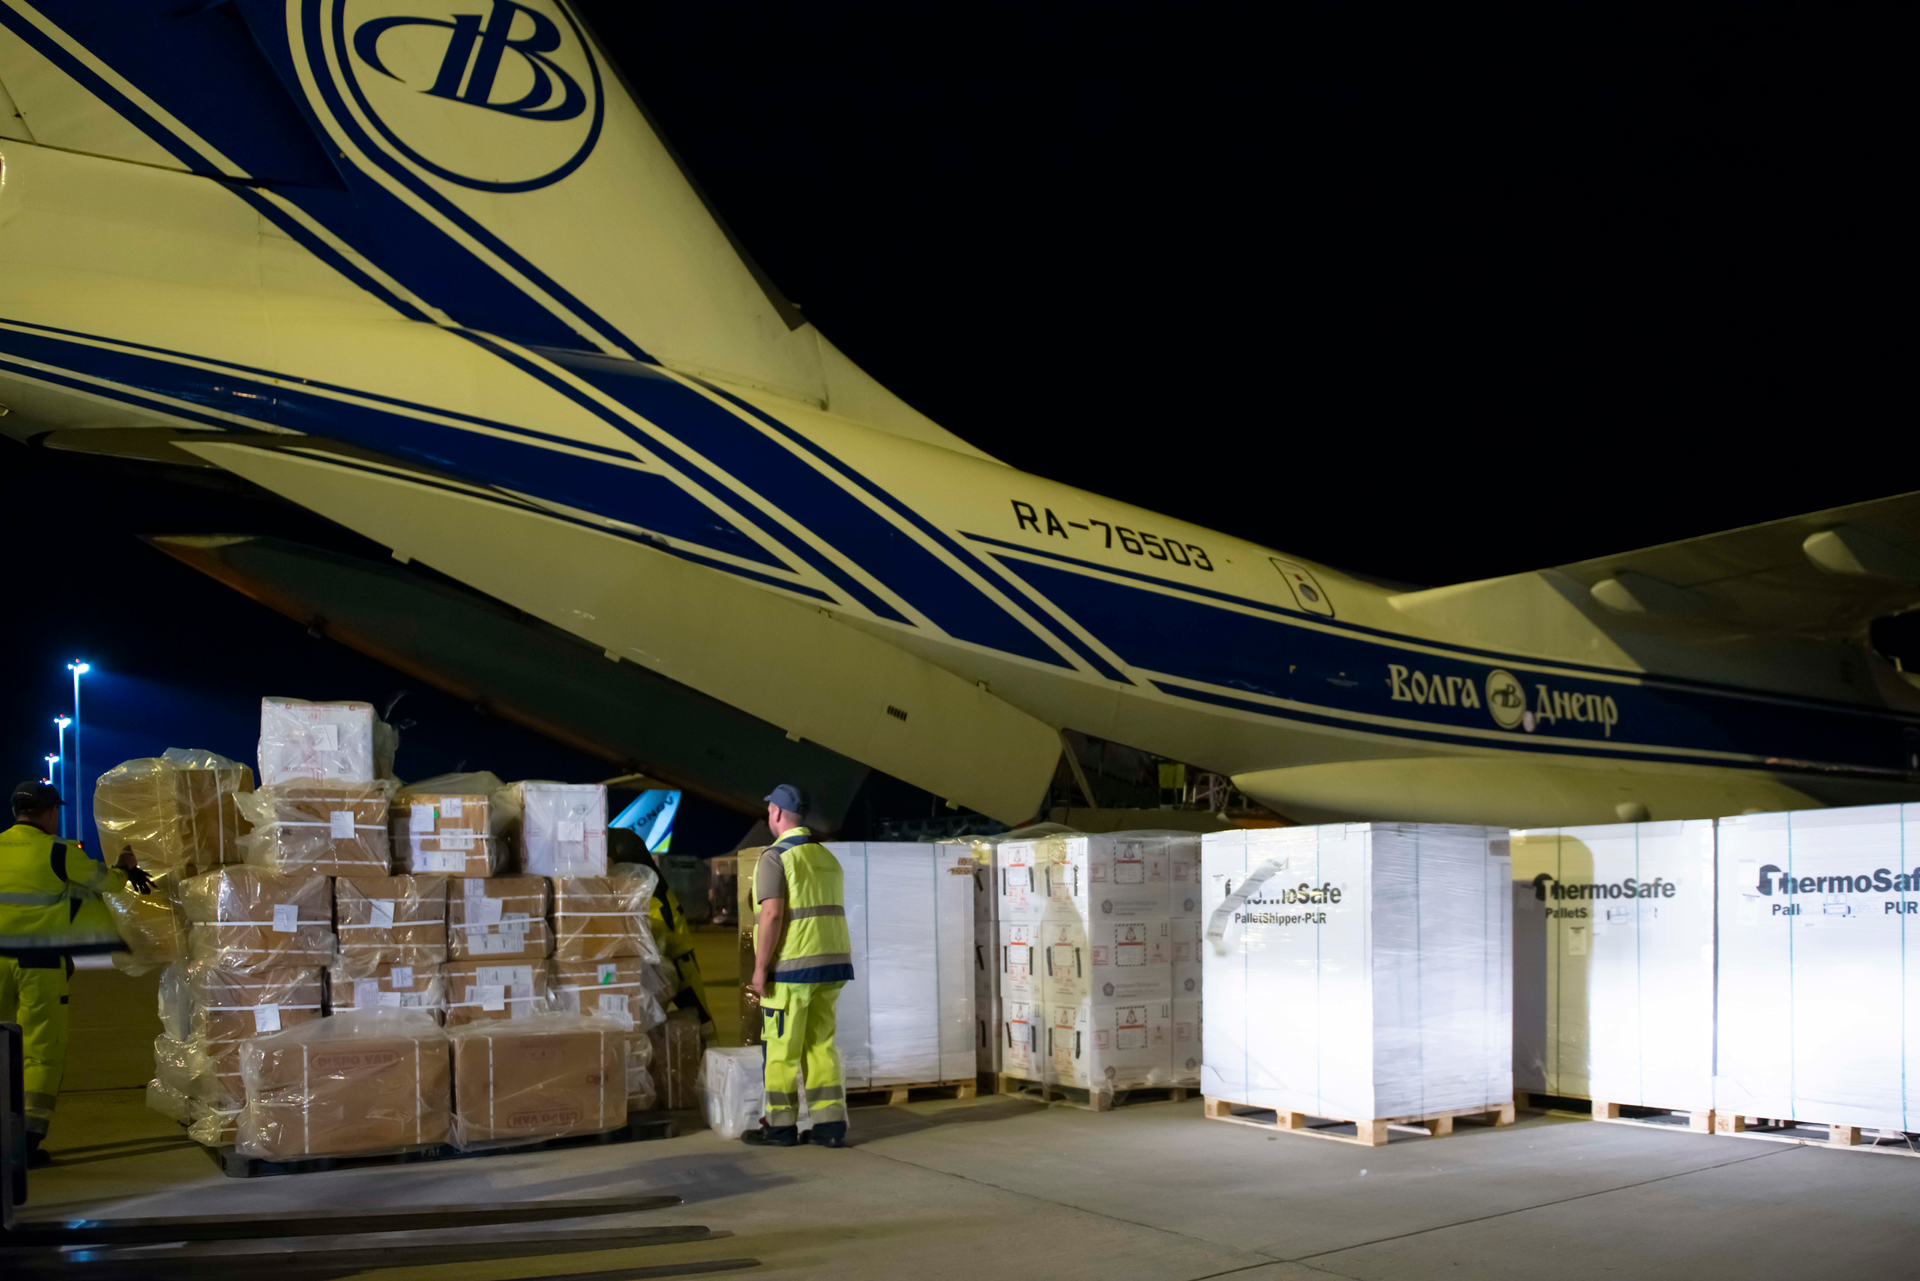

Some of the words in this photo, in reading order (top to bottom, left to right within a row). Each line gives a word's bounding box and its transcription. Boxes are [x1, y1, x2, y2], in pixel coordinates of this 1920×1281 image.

[1010, 499, 1214, 572] RA-76503
[629, 796, 674, 831] TONOV
[1532, 873, 1676, 901] ThermoSafe
[1755, 864, 1920, 896] ThermoSaf
[1234, 912, 1327, 926] PalletShipper-PUR
[364, 1053, 393, 1064] VAN
